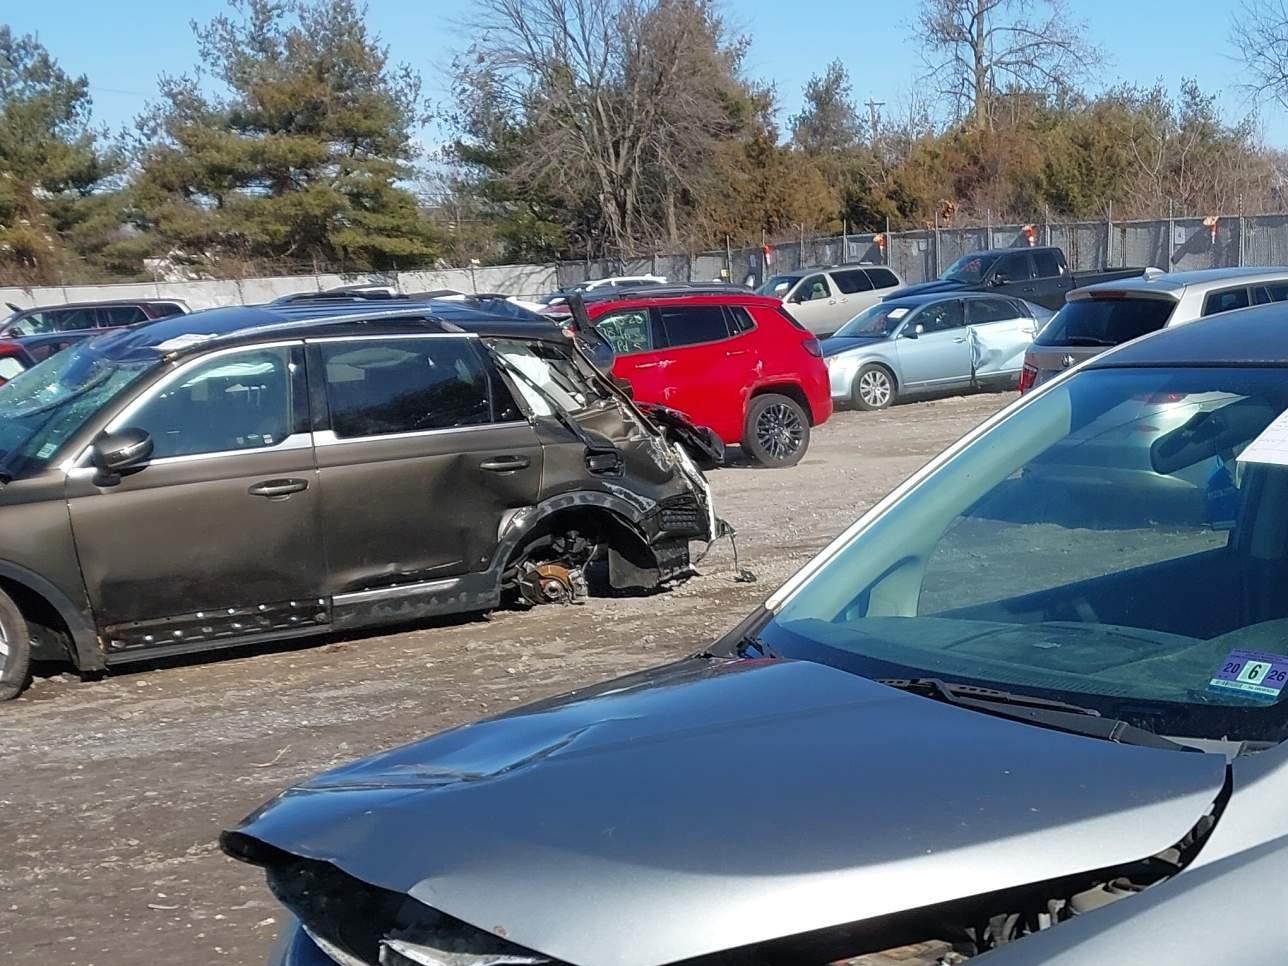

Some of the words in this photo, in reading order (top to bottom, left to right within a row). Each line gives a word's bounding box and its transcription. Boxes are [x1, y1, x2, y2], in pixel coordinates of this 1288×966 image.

[1223, 662, 1241, 674] 20
[1248, 664, 1262, 680] 6
[1267, 670, 1287, 681] 26
